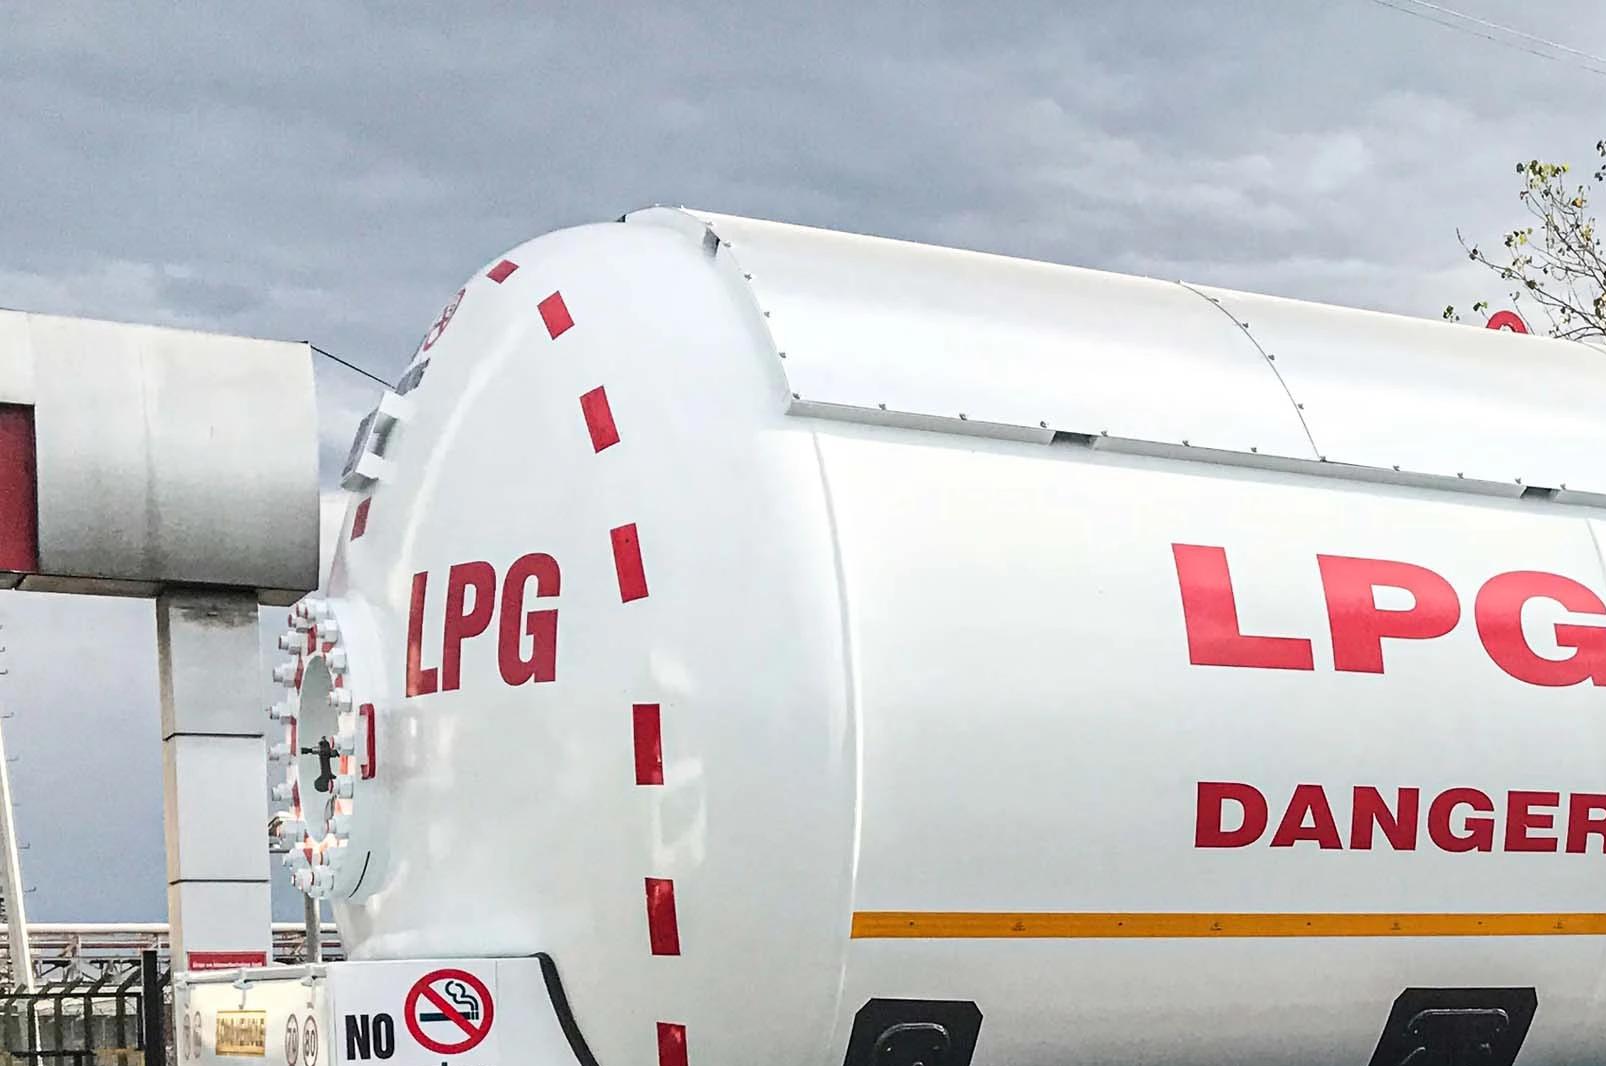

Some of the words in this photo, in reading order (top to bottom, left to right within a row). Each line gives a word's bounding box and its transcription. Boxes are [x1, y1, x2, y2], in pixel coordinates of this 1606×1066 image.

[406, 552, 561, 698] LPG
[287, 1027, 298, 1052] 70
[304, 1029, 316, 1057] 80
[345, 1013, 395, 1060] NO
